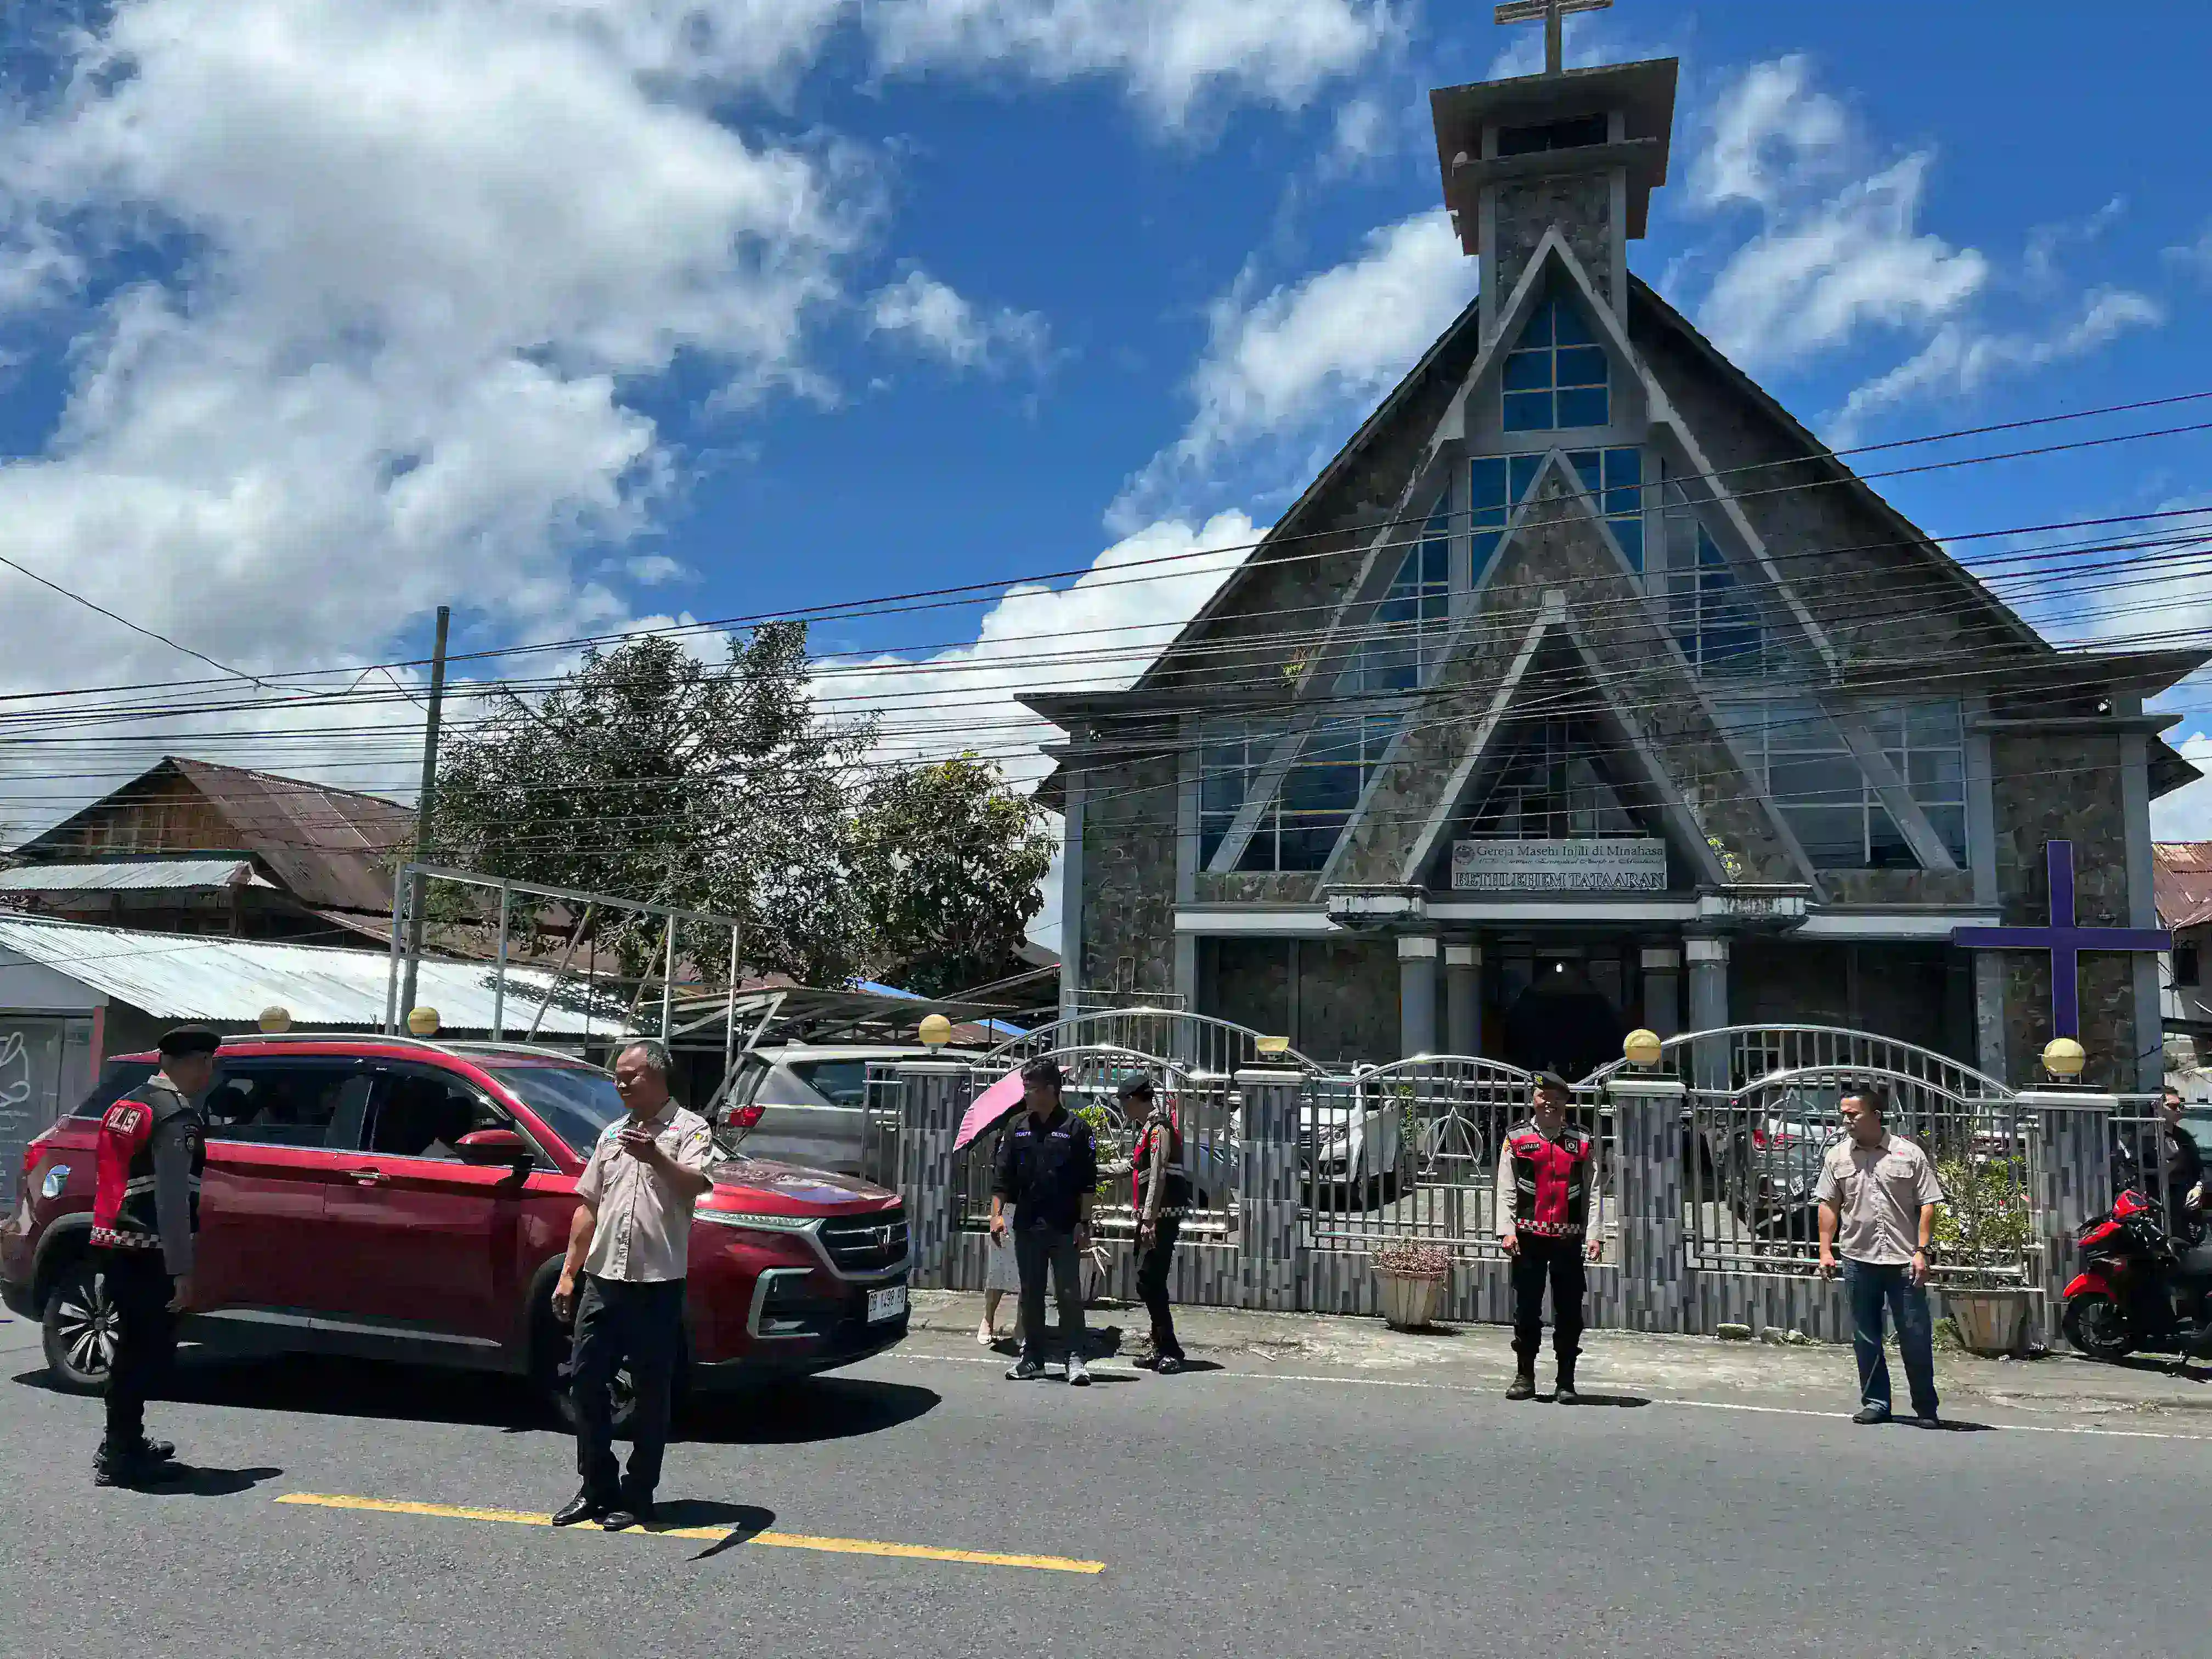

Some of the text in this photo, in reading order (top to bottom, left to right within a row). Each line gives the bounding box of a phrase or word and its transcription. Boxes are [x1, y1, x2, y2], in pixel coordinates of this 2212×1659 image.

[1477, 845, 1663, 857] Gereja Masehi Injili di Minahasa
[1455, 872, 1664, 887] BETHLEHEM TATAARAN
